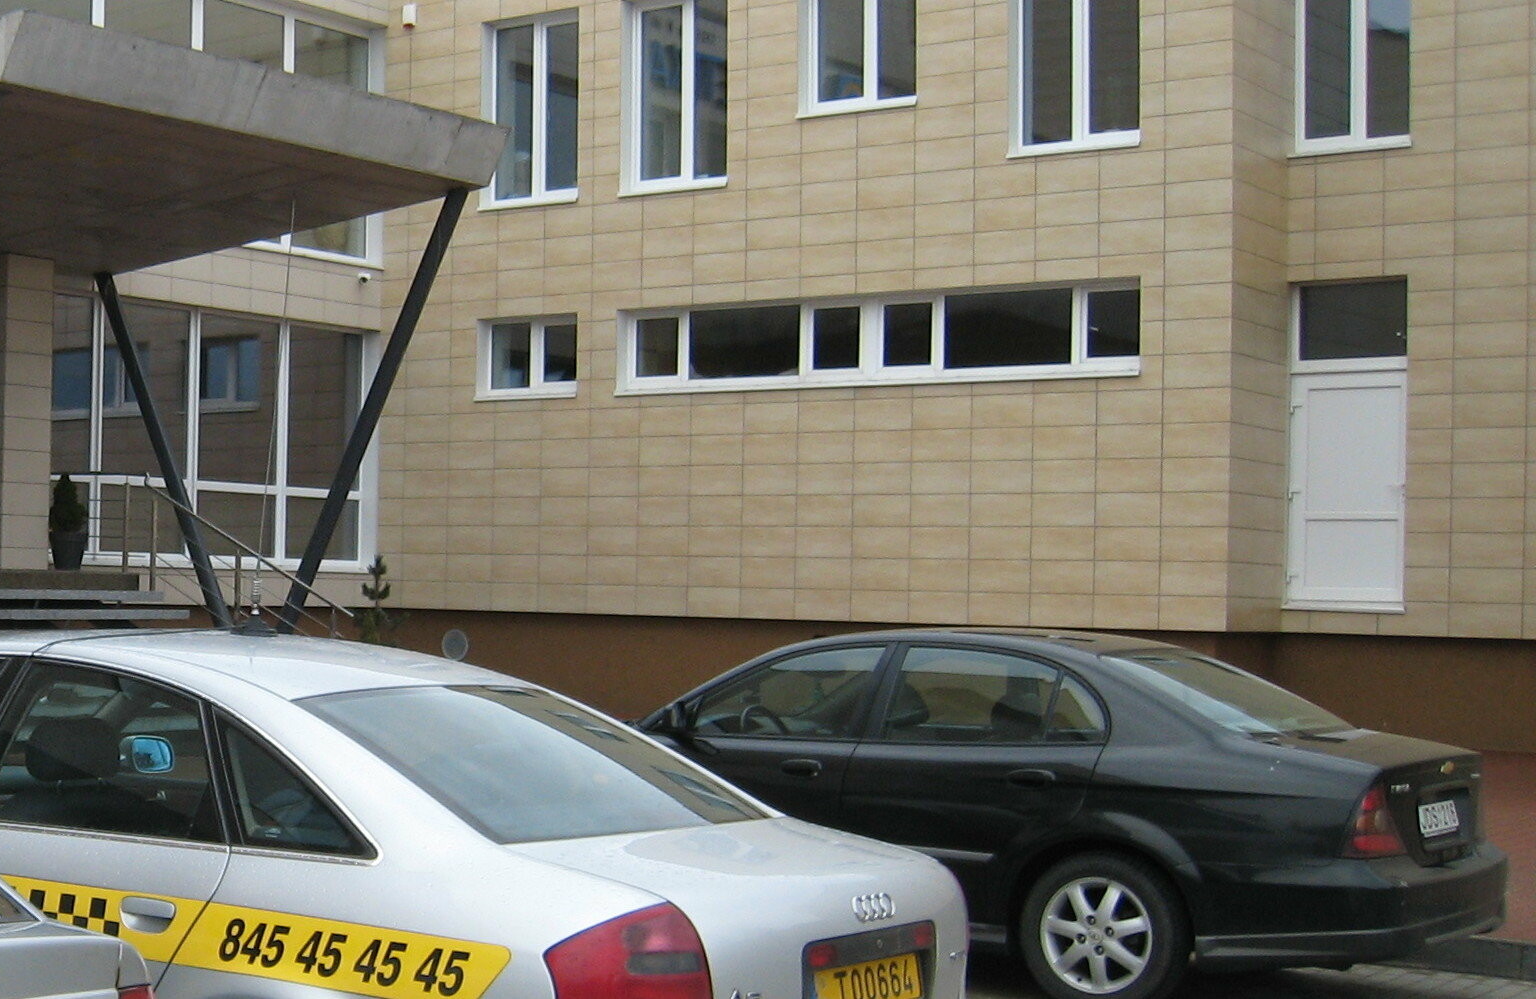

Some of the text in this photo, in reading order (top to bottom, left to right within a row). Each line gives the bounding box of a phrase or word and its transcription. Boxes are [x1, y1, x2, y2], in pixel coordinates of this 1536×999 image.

[219, 918, 471, 997] 845 45 45 45
[834, 959, 913, 999] T00664
